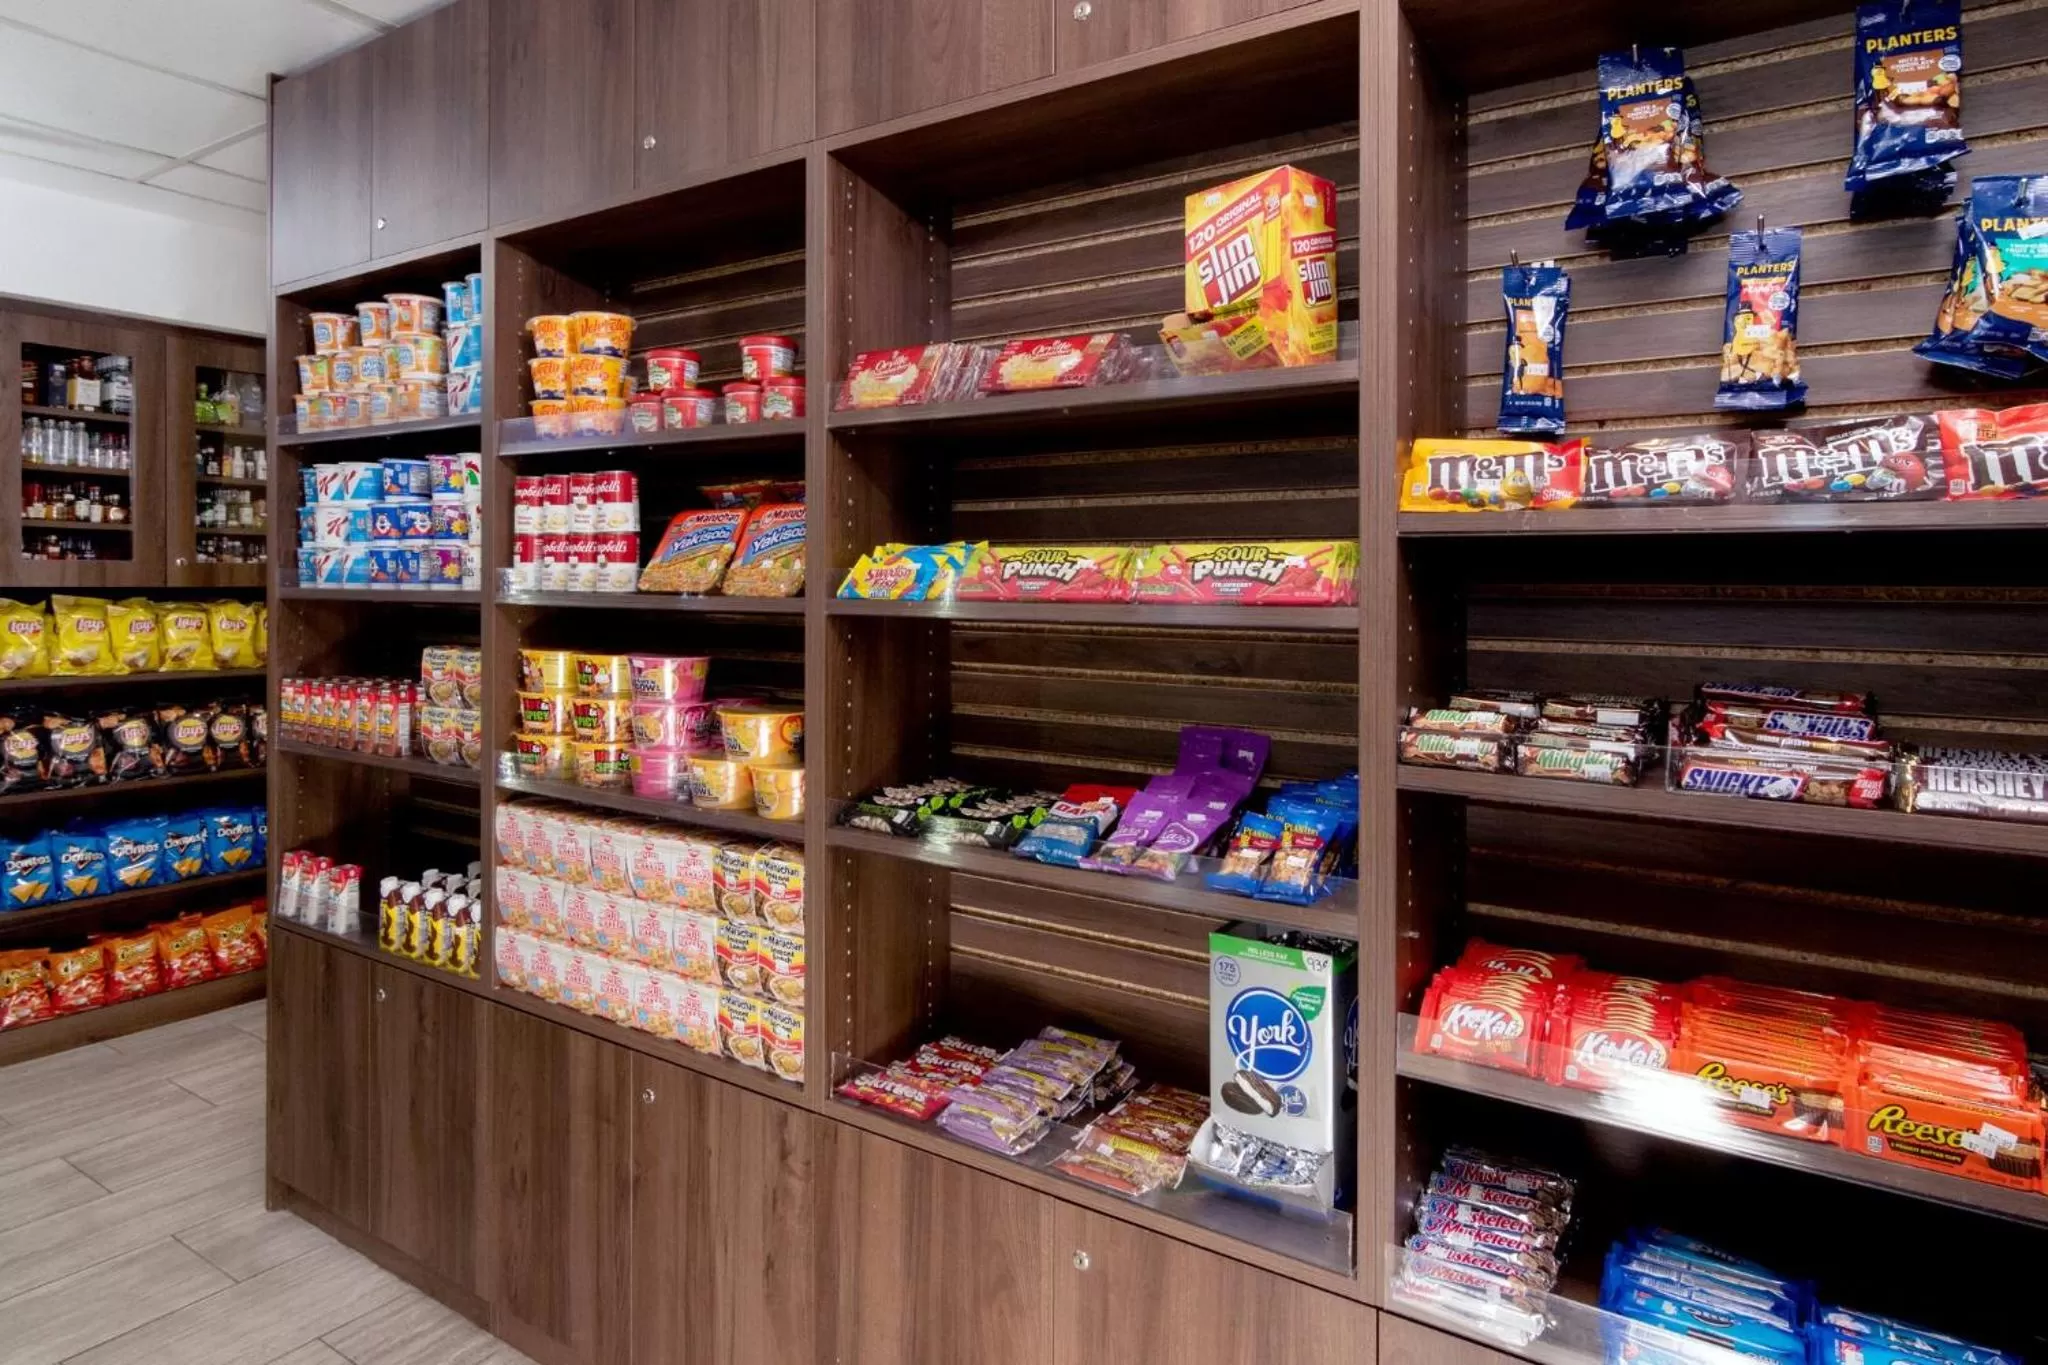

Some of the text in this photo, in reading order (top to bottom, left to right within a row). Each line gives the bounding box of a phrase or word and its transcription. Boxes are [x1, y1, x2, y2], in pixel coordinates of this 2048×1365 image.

[1866, 27, 1958, 54] PLANTERS
[1607, 77, 1684, 101] PLANTERS
[1188, 224, 1216, 255] 120
[1216, 193, 1262, 227] ORIGINAL
[1292, 239, 1310, 255] 120
[1736, 261, 1795, 277] PLANTERS
[696, 512, 740, 523] Maruchan
[1022, 549, 1069, 563] SOUR
[1214, 546, 1270, 562] SOUR
[1001, 560, 1081, 585] PUNCH
[1192, 559, 1288, 586] PUNCH
[1425, 709, 1469, 727] Milky
[1536, 749, 1585, 771] Milky
[1218, 961, 1236, 974] 175
[1228, 1012, 1303, 1070] York
